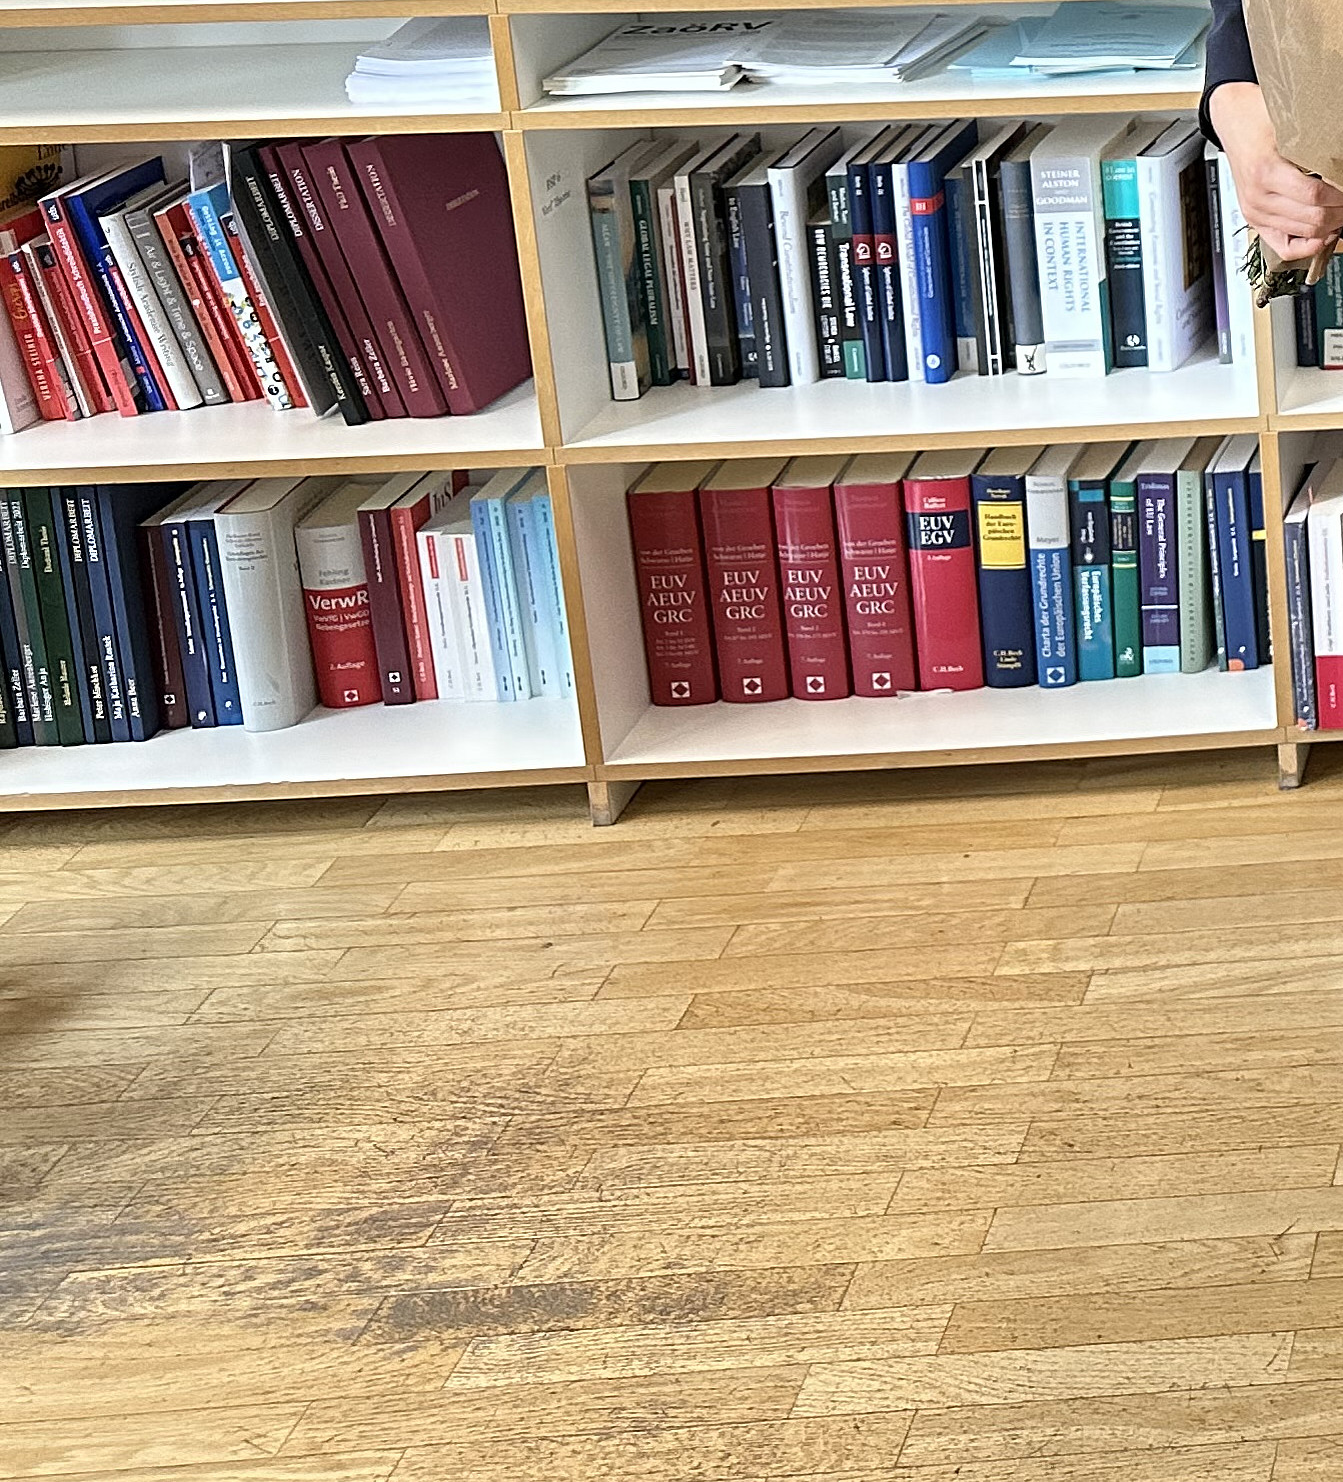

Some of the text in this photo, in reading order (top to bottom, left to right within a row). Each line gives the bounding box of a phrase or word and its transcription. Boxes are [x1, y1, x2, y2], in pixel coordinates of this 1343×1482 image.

[622, 20, 775, 36] ZaöRV
[246, 175, 280, 241] DIPLOMARBEIT
[269, 172, 304, 237] DIPLOMARBEIT
[292, 168, 326, 231] DISSERTATION
[638, 219, 650, 252] GLOBAL
[641, 254, 653, 277] LEGAL
[1043, 222, 1058, 290] IN CONTEXT
[1059, 222, 1075, 312] HUMAN RIGHTS
[1074, 221, 1090, 313] INTERNATIONAL
[838, 243, 856, 327] Transnational Law
[144, 245, 205, 371] Air & Light & Time & Space
[370, 363, 391, 393] Barbara
[66, 498, 83, 562] DIPLOMARBEIT
[82, 498, 99, 561] DIPLOMARBEIT
[920, 516, 954, 531] EUV
[921, 531, 955, 545] EGV
[651, 574, 687, 589] EUV
[724, 570, 760, 586] EUV
[788, 569, 823, 584] EUV
[854, 566, 890, 580] EUV
[647, 591, 696, 607] AEUV
[720, 587, 768, 603] AEUV
[785, 586, 831, 601] AEUV
[850, 582, 899, 598] AEUV
[309, 591, 369, 611] VerwR
[791, 603, 827, 618] GRC
[856, 600, 895, 615] GRC
[1037, 553, 1052, 658] Charta der Grundrechte
[1051, 552, 1066, 657] der Europäischen Union
[654, 609, 693, 624] GRC
[726, 605, 765, 620] GRC
